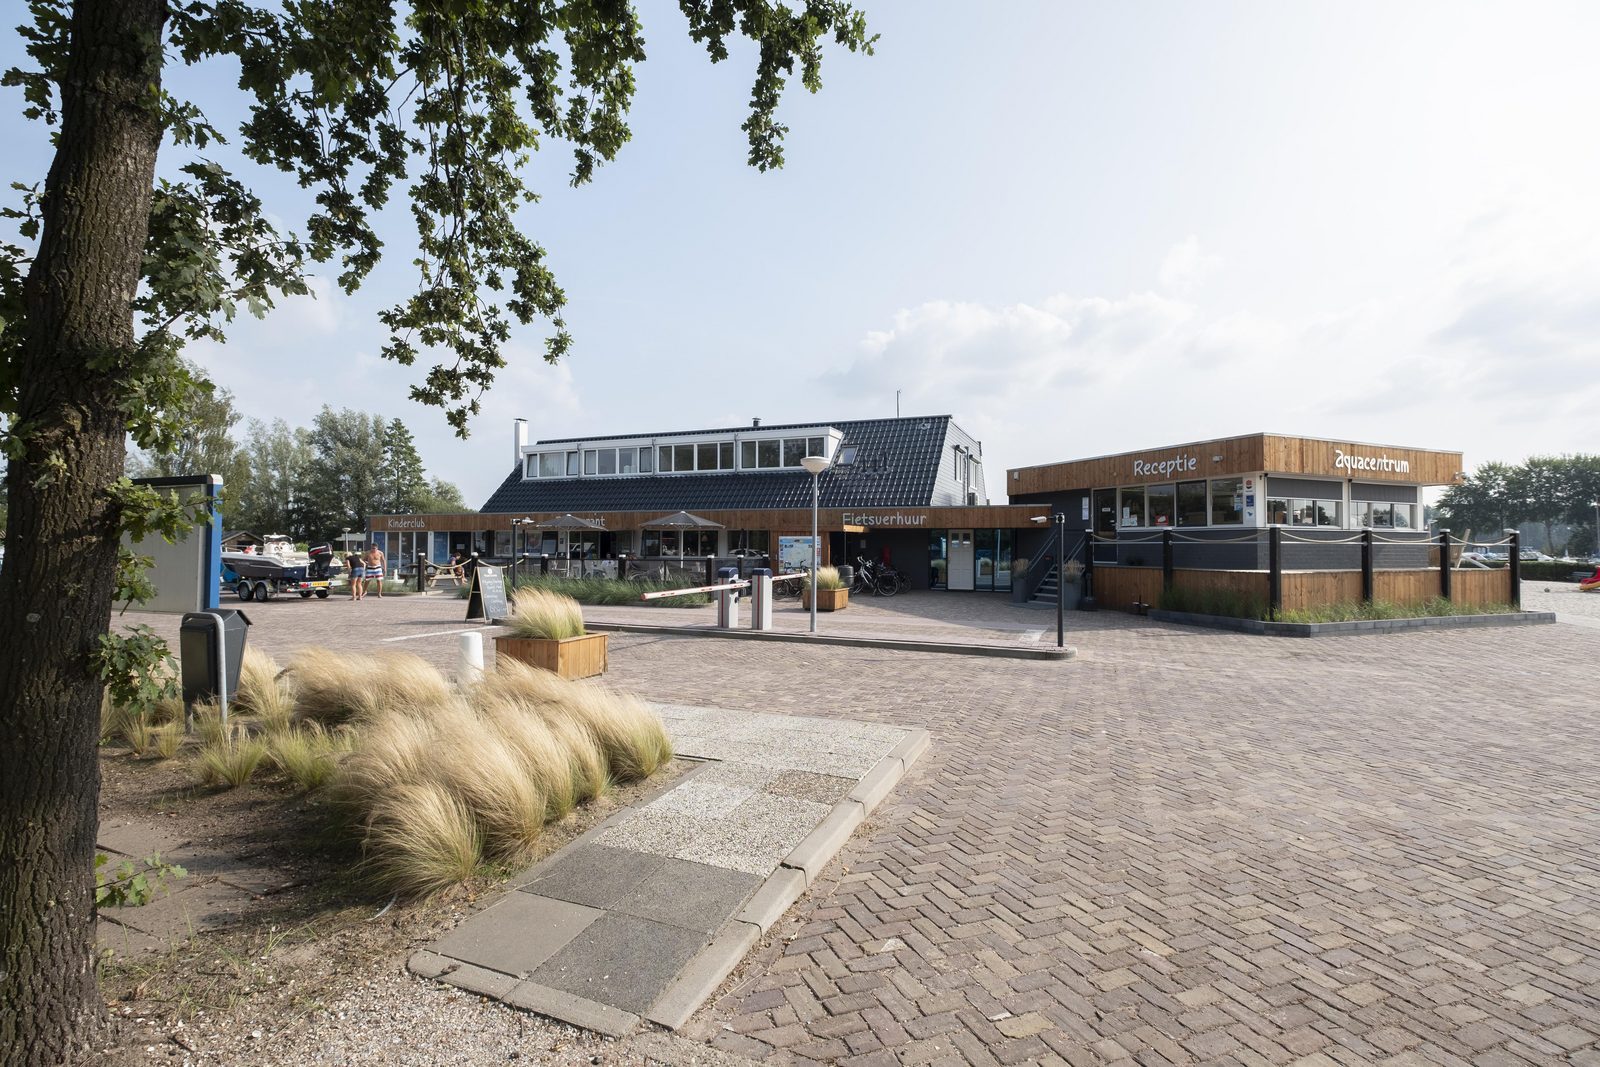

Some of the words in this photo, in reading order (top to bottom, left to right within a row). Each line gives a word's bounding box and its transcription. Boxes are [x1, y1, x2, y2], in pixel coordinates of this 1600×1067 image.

[1134, 453, 1197, 479] Receptie
[387, 517, 426, 528] Kinderclub
[842, 511, 927, 526] Fietsverhuur
